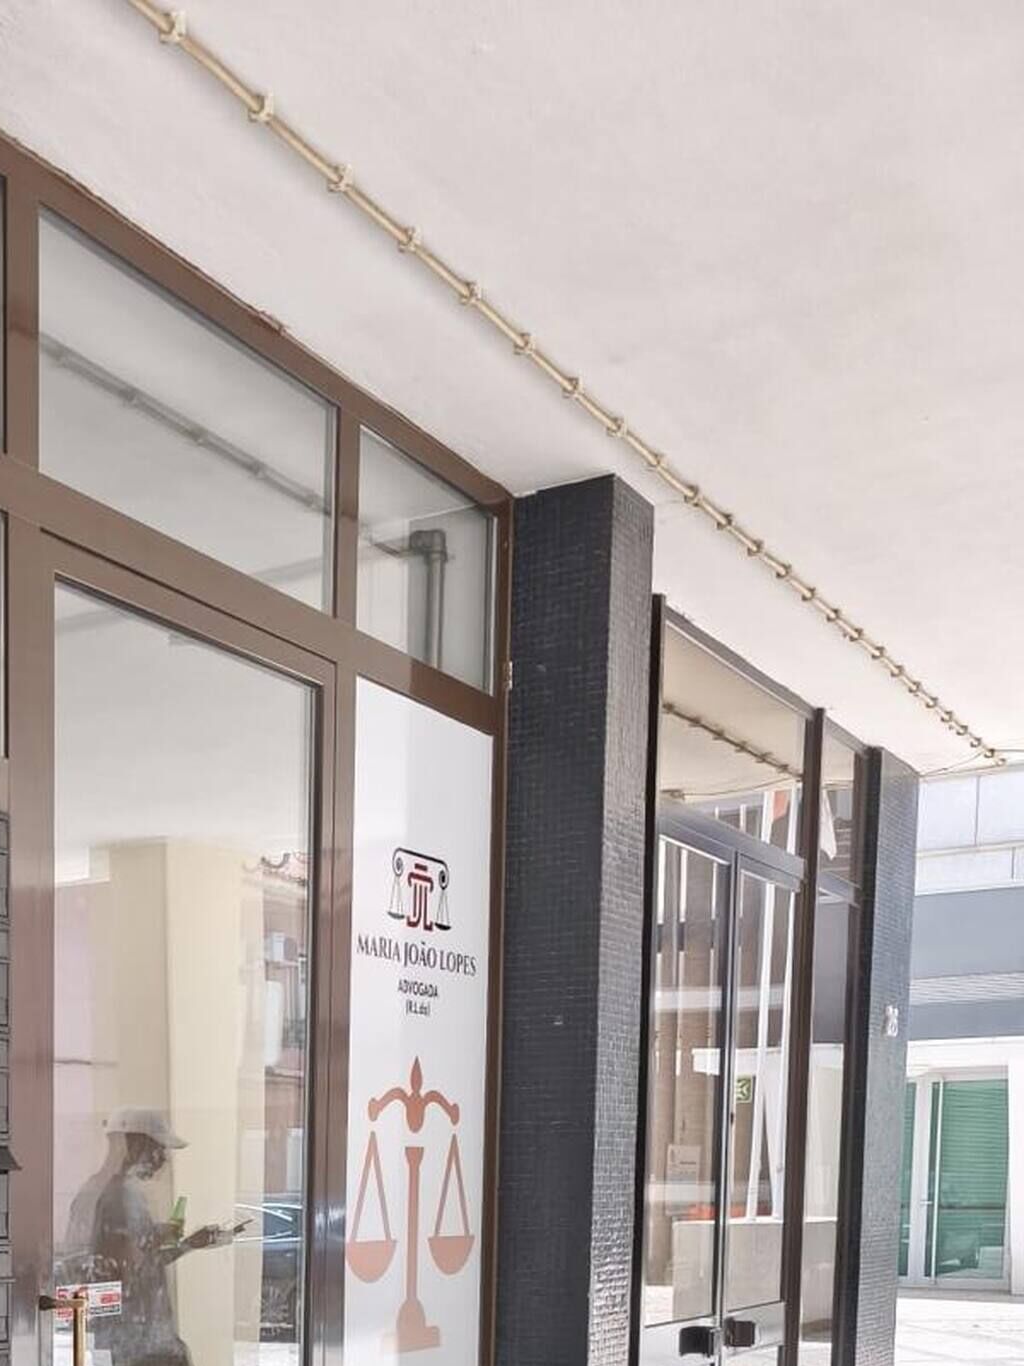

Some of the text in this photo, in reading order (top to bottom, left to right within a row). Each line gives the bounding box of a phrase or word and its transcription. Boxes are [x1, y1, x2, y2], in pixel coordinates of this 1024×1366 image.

[356, 933, 477, 976] MARIA JOÃO LOPES
[398, 979, 439, 998] ADVOGADA
